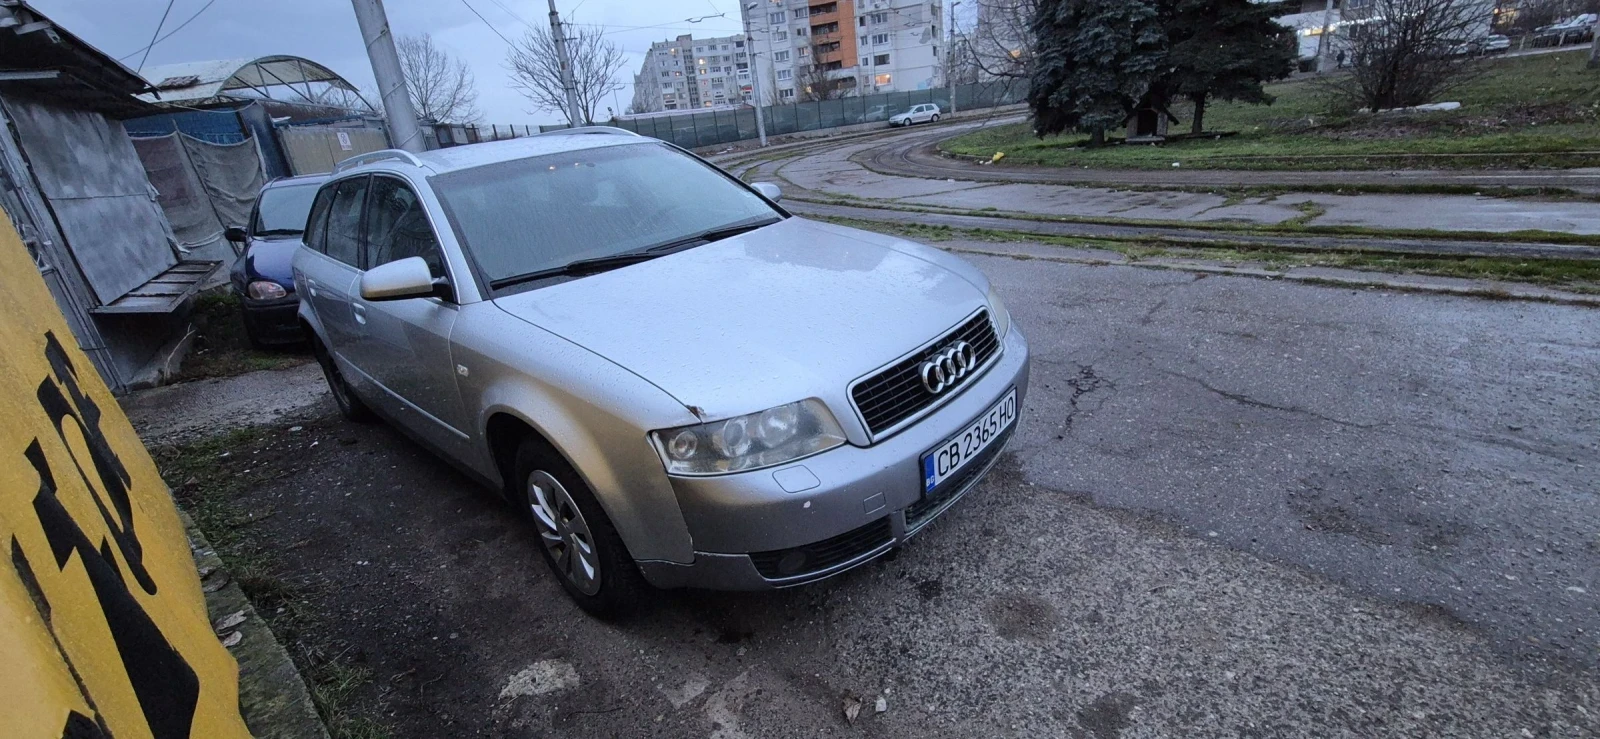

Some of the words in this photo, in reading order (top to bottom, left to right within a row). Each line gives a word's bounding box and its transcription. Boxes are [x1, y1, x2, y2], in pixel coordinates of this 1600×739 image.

[938, 442, 960, 477] CB
[963, 410, 997, 459] 2365
[999, 396, 1014, 429] HO
[926, 475, 935, 487] BG
